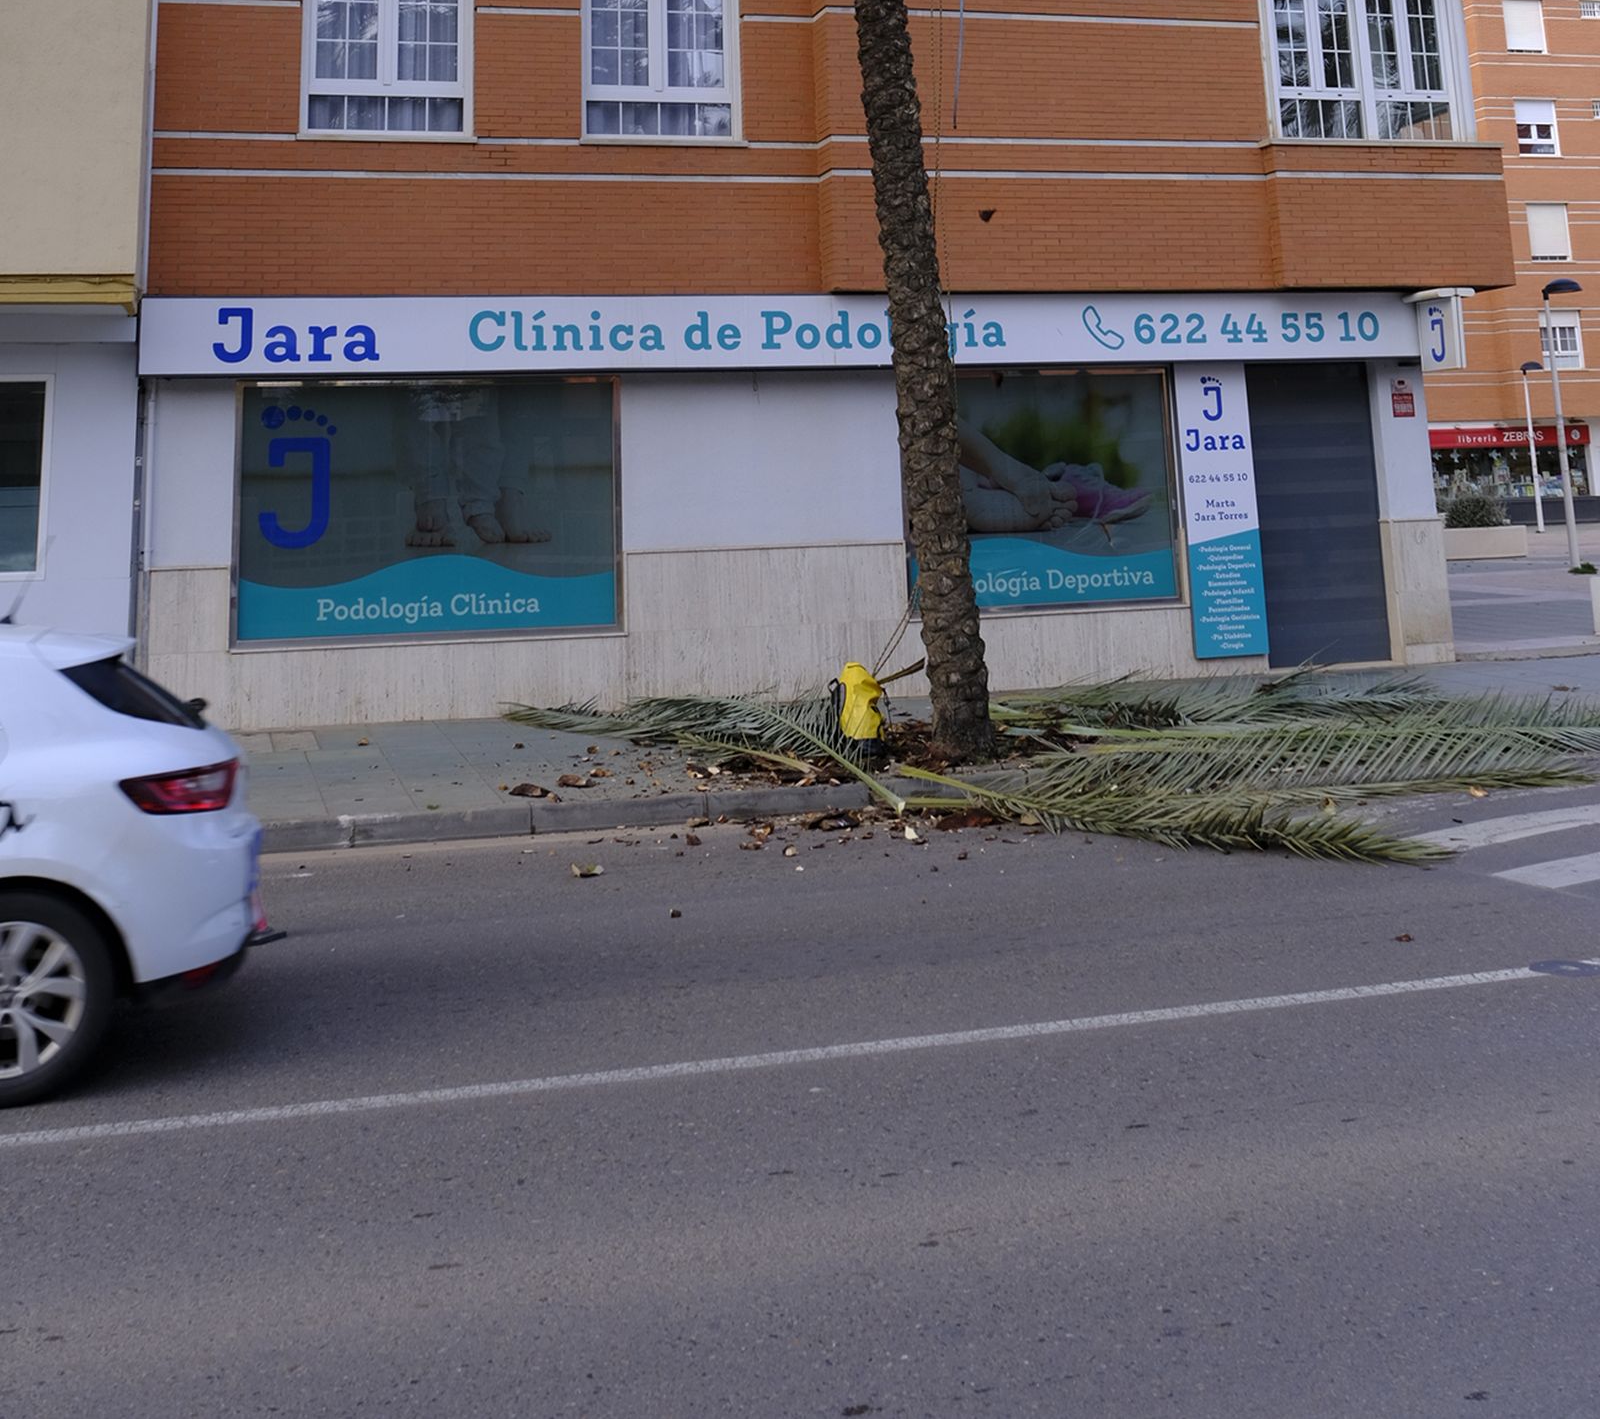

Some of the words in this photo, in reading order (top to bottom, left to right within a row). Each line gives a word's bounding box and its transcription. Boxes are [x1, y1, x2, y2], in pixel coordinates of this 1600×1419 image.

[212, 307, 380, 363] Jara
[468, 310, 666, 352] Clínica
[684, 311, 742, 351] de
[1134, 313, 1207, 344] 622
[1220, 313, 1268, 343] 44
[1281, 312, 1325, 342] 55
[1338, 311, 1380, 342] 10
[1186, 429, 1245, 452] Jara
[1189, 474, 1207, 483] 622
[1209, 474, 1221, 483] 44
[1223, 473, 1235, 482] 55
[1237, 472, 1248, 482] 10
[1194, 512, 1216, 522] Jara
[1218, 511, 1248, 520] Torres
[1206, 499, 1236, 508] Marta
[1046, 566, 1154, 593] Deportiva
[316, 594, 443, 624] Podología
[450, 592, 540, 615] Clínica
